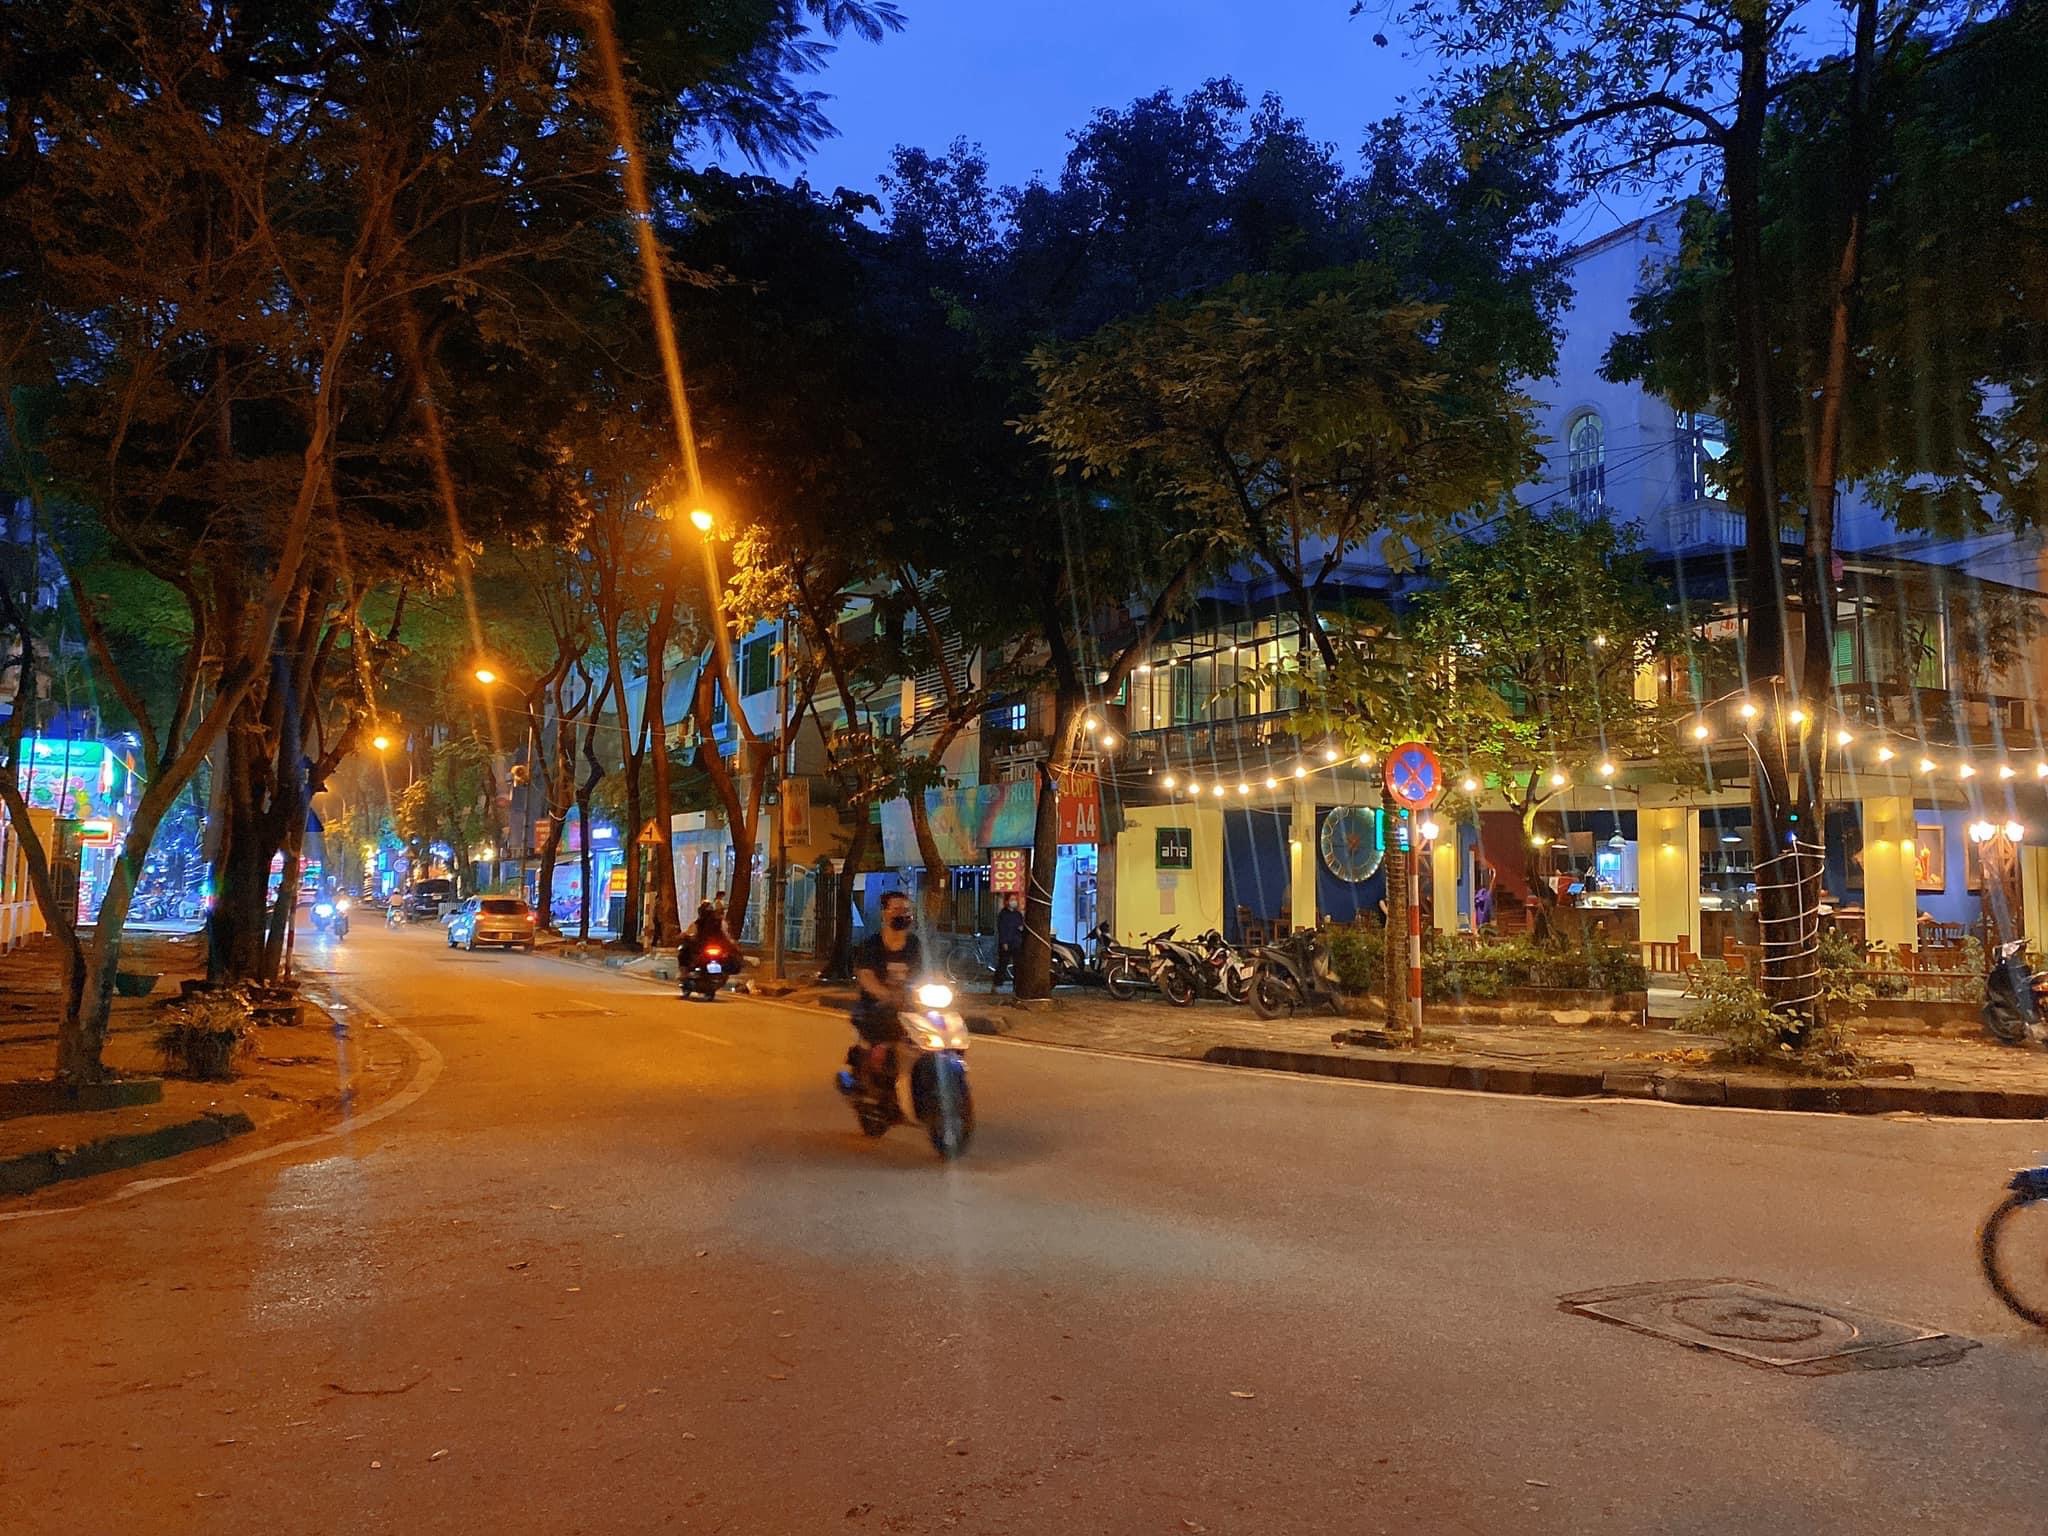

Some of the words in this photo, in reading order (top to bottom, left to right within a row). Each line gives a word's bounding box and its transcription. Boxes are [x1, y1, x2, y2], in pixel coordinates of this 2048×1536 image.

[1075, 802, 1097, 838] A4
[1161, 839, 1188, 857] aha
[992, 850, 1019, 859] PHO
[994, 860, 1017, 870] TO
[994, 871, 1017, 880] CO
[995, 881, 1016, 890] PY
